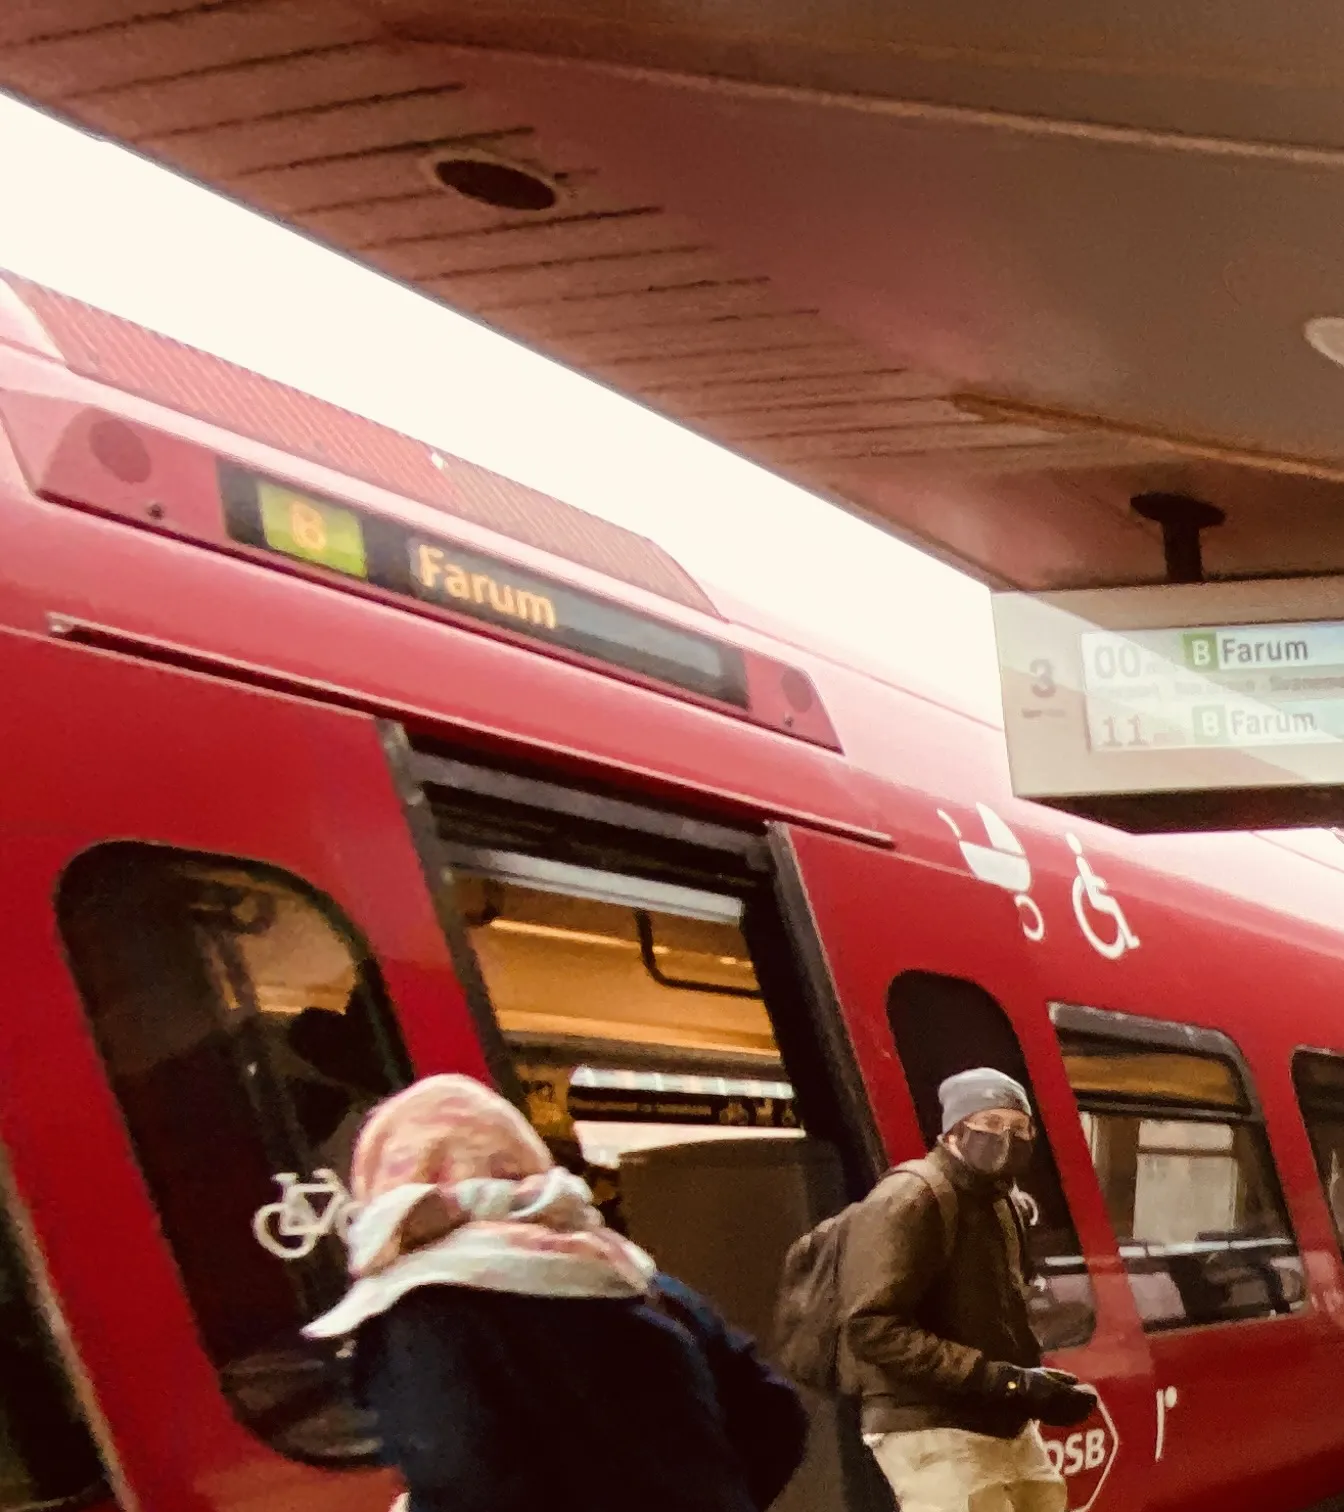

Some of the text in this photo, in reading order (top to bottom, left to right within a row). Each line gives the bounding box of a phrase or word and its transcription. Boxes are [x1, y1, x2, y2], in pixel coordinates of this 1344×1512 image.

[418, 544, 557, 630] Farum
[1029, 658, 1057, 699] 3
[1094, 643, 1142, 680] 00
[1191, 638, 1211, 666] B
[1221, 637, 1309, 665] Farum
[1102, 714, 1149, 748] 11
[1230, 709, 1318, 736] Farum
